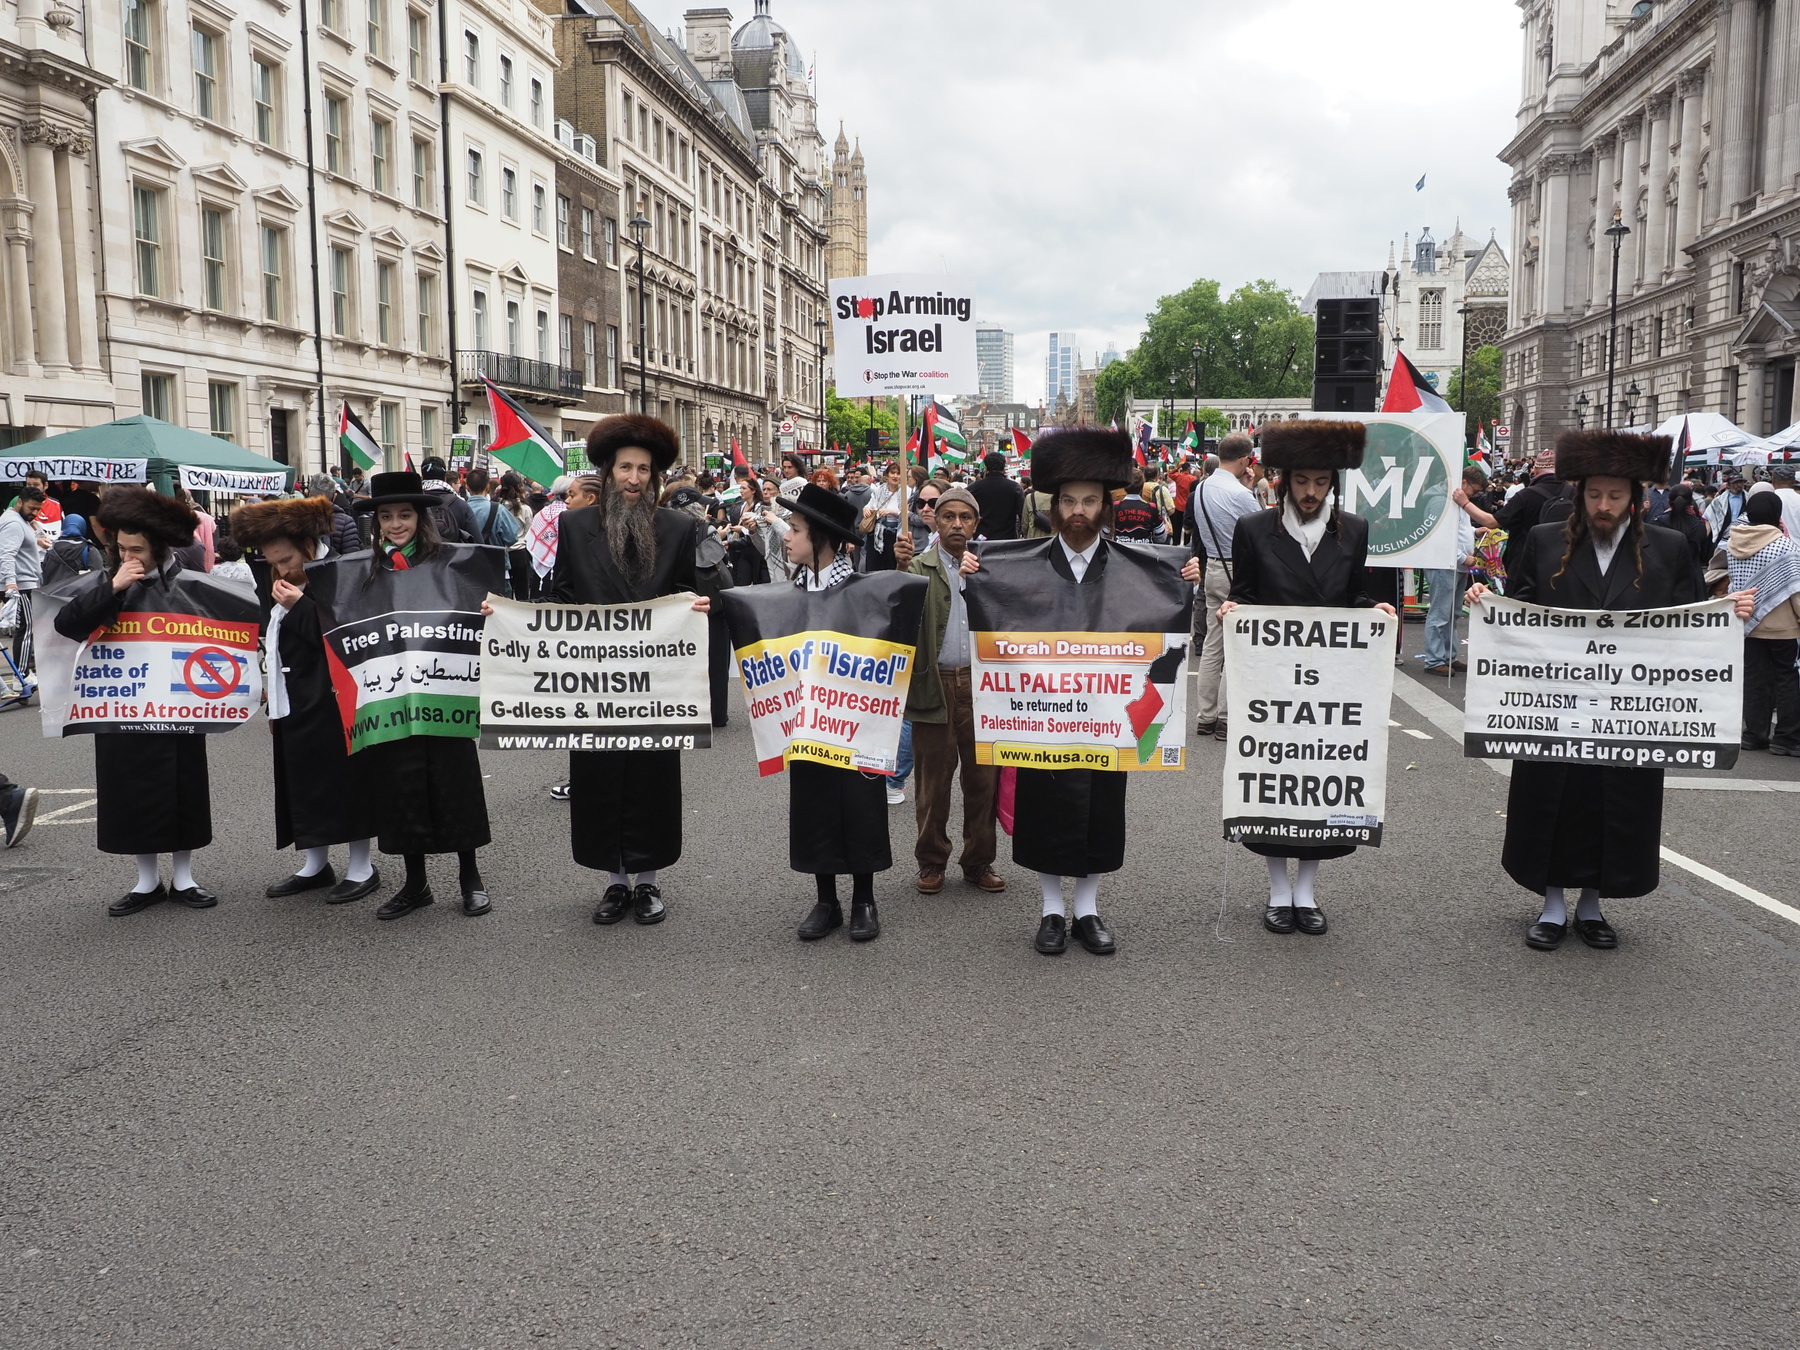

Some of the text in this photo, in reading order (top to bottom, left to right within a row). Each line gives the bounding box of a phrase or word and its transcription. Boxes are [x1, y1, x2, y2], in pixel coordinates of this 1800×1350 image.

[887, 291, 971, 322] Arming
[866, 323, 942, 354] Israel
[874, 371, 888, 380] Stop
[901, 370, 918, 378] War
[919, 370, 948, 378] coalition
[5, 458, 136, 479] COUNTERFIRE
[188, 470, 280, 491] COUNTERFIRE
[1410, 513, 1437, 541] VOICE
[527, 608, 652, 632] JUDAISM
[1483, 606, 1730, 628] Judaism & Zionism
[147, 616, 250, 644] Condemns
[342, 622, 484, 654] Free Palestine
[1236, 618, 1386, 650] “ISRAEL”
[91, 645, 125, 660] the
[488, 639, 697, 663] G-dly & Compassionate
[996, 640, 1146, 656] Torah Demands
[1586, 640, 1618, 655] Are
[74, 663, 149, 681] State of
[742, 640, 906, 690] State of "Israel"
[1294, 664, 1320, 686] is
[1476, 658, 1733, 686] Diametrically Opposed
[534, 672, 651, 693] ZIONISM
[980, 672, 1132, 694] ALL PALESTINE
[69, 701, 249, 720] And its Atrocities
[491, 701, 698, 719] G-dless & Merciless
[752, 694, 782, 720] does
[810, 684, 900, 718] represent
[1010, 698, 1088, 712] be returned to
[1248, 699, 1362, 726] STATE
[1499, 692, 1578, 710] JUDAISM
[1610, 696, 1703, 714] RELIGION.
[120, 723, 195, 734] www.NKUSA.org
[810, 707, 860, 742] Jewry
[980, 714, 1122, 738] Palestinian Sovereignty
[1487, 714, 1716, 738] ZIONISM = NATIONALISM
[498, 734, 695, 750] www.nkEurope.org
[1238, 735, 1368, 764] Organized
[1000, 750, 1110, 767] www.nkusa.org
[1484, 740, 1716, 768] www.nkEurope.org
[1238, 772, 1365, 808] TERROR
[1230, 824, 1370, 840] www.nkEurope.org
